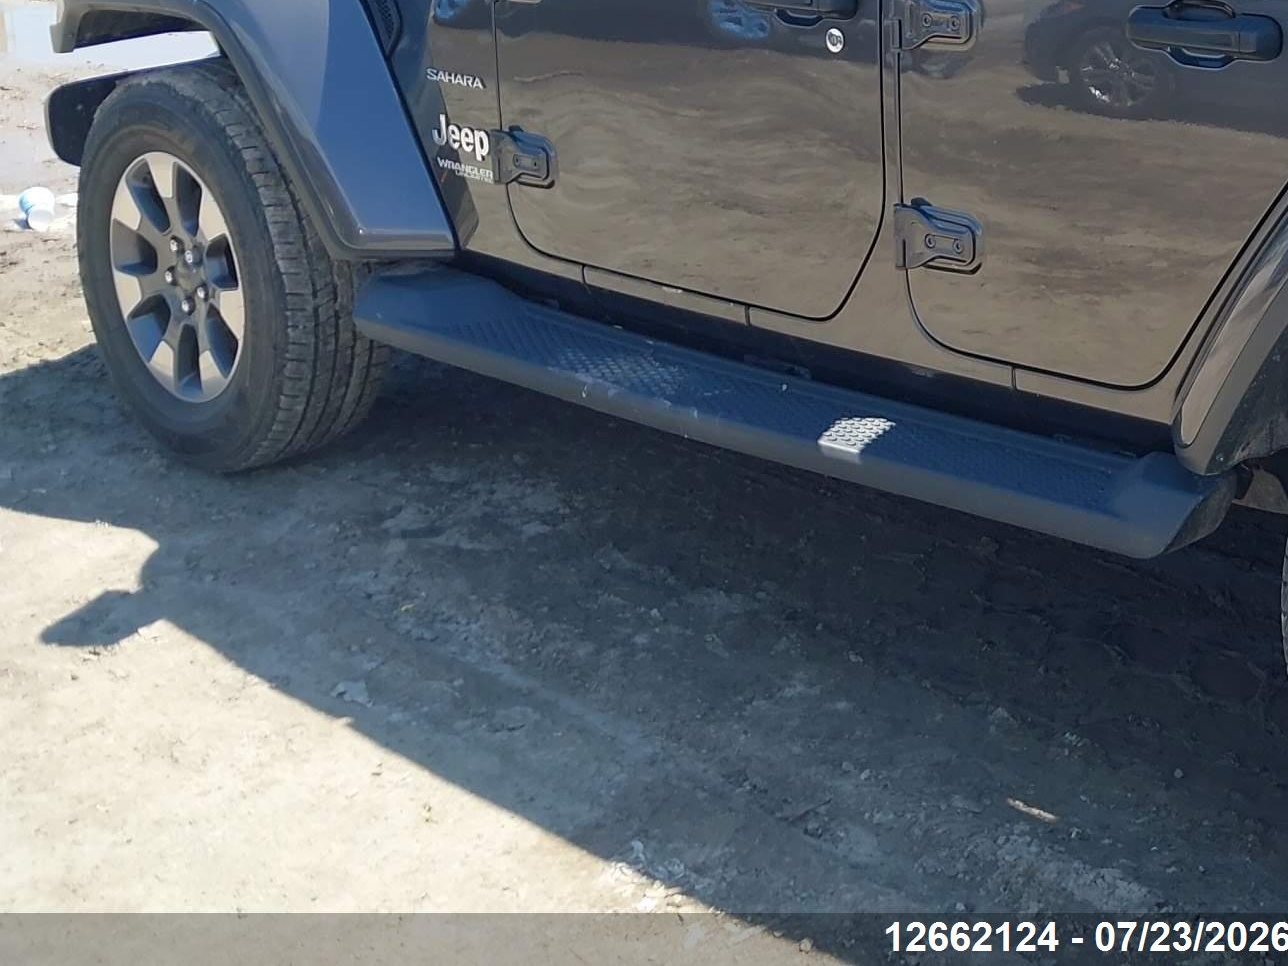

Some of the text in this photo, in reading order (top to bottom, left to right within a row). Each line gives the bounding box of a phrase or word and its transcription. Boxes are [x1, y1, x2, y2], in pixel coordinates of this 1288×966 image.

[426, 67, 484, 90] SAHARA
[431, 113, 490, 162] Jeep
[437, 156, 494, 180] WRANGLER
